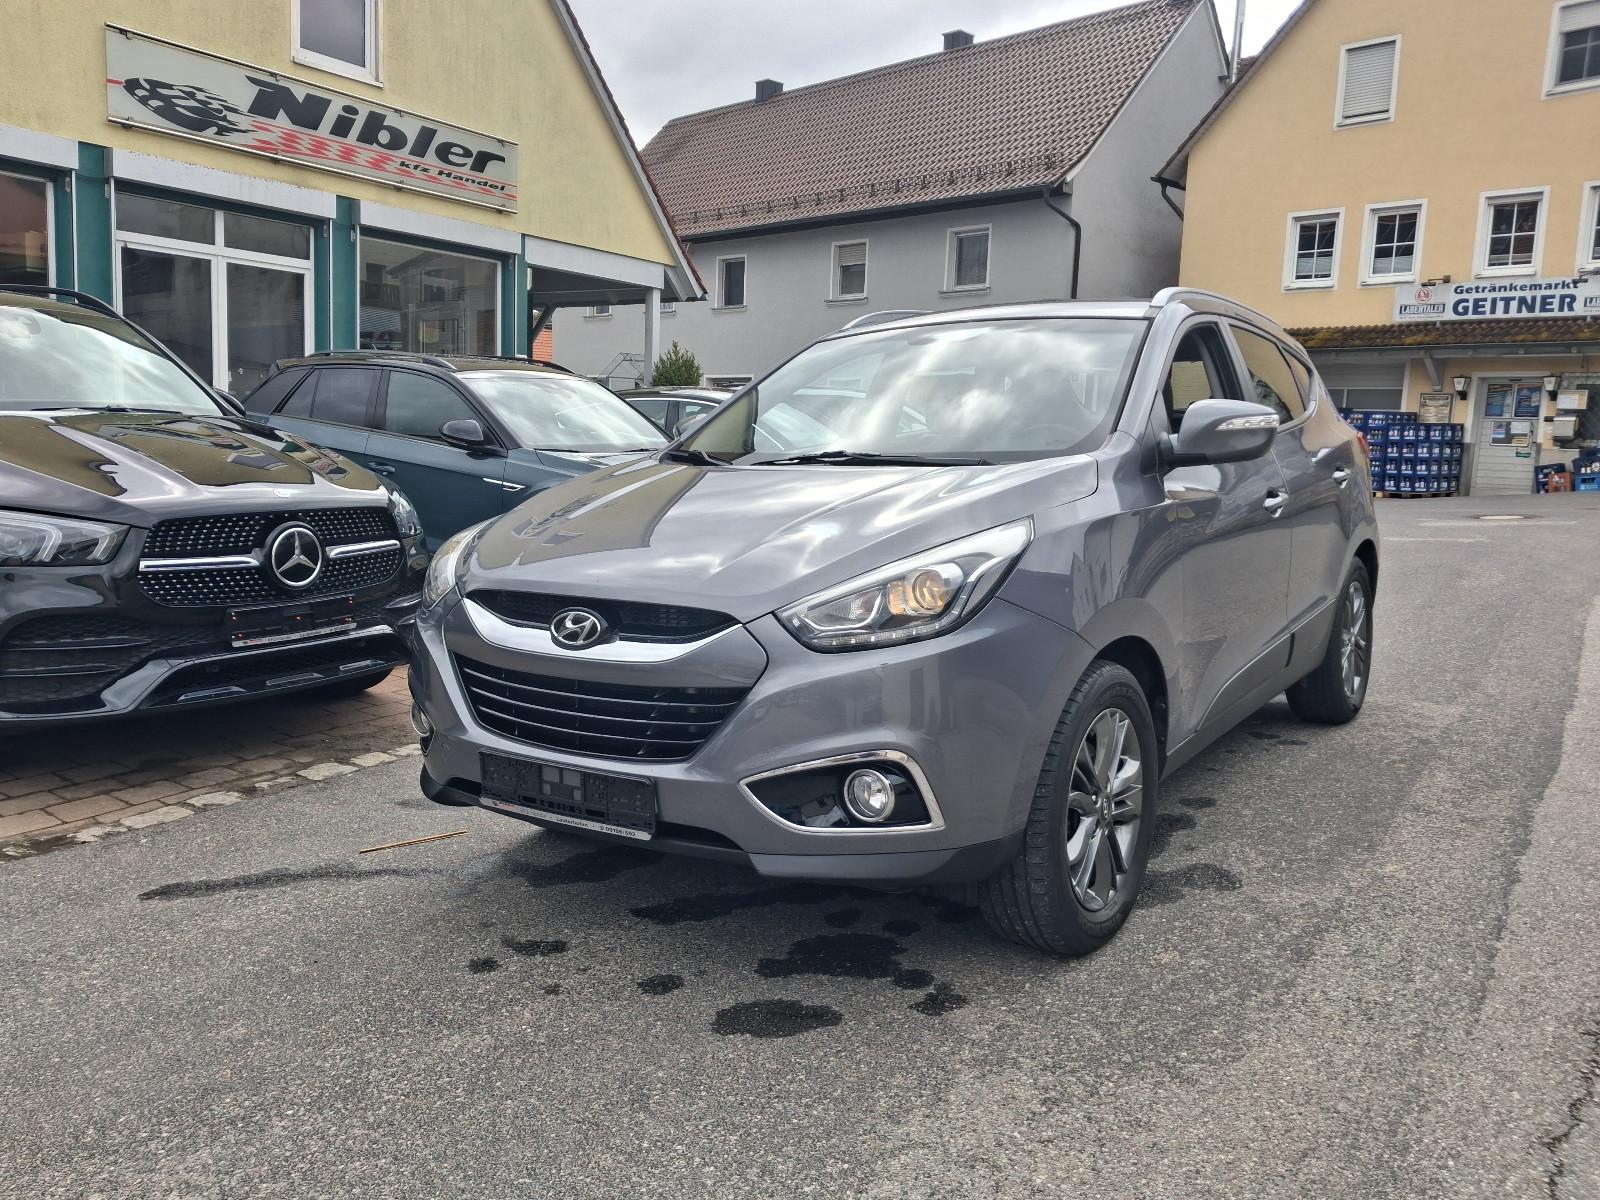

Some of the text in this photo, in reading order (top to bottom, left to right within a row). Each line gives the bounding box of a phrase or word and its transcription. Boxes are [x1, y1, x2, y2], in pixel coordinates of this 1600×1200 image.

[245, 75, 505, 174] Nibler
[437, 169, 506, 191] Handel
[1453, 279, 1580, 295] Getränkemarkt
[1452, 293, 1577, 316] GEITNER
